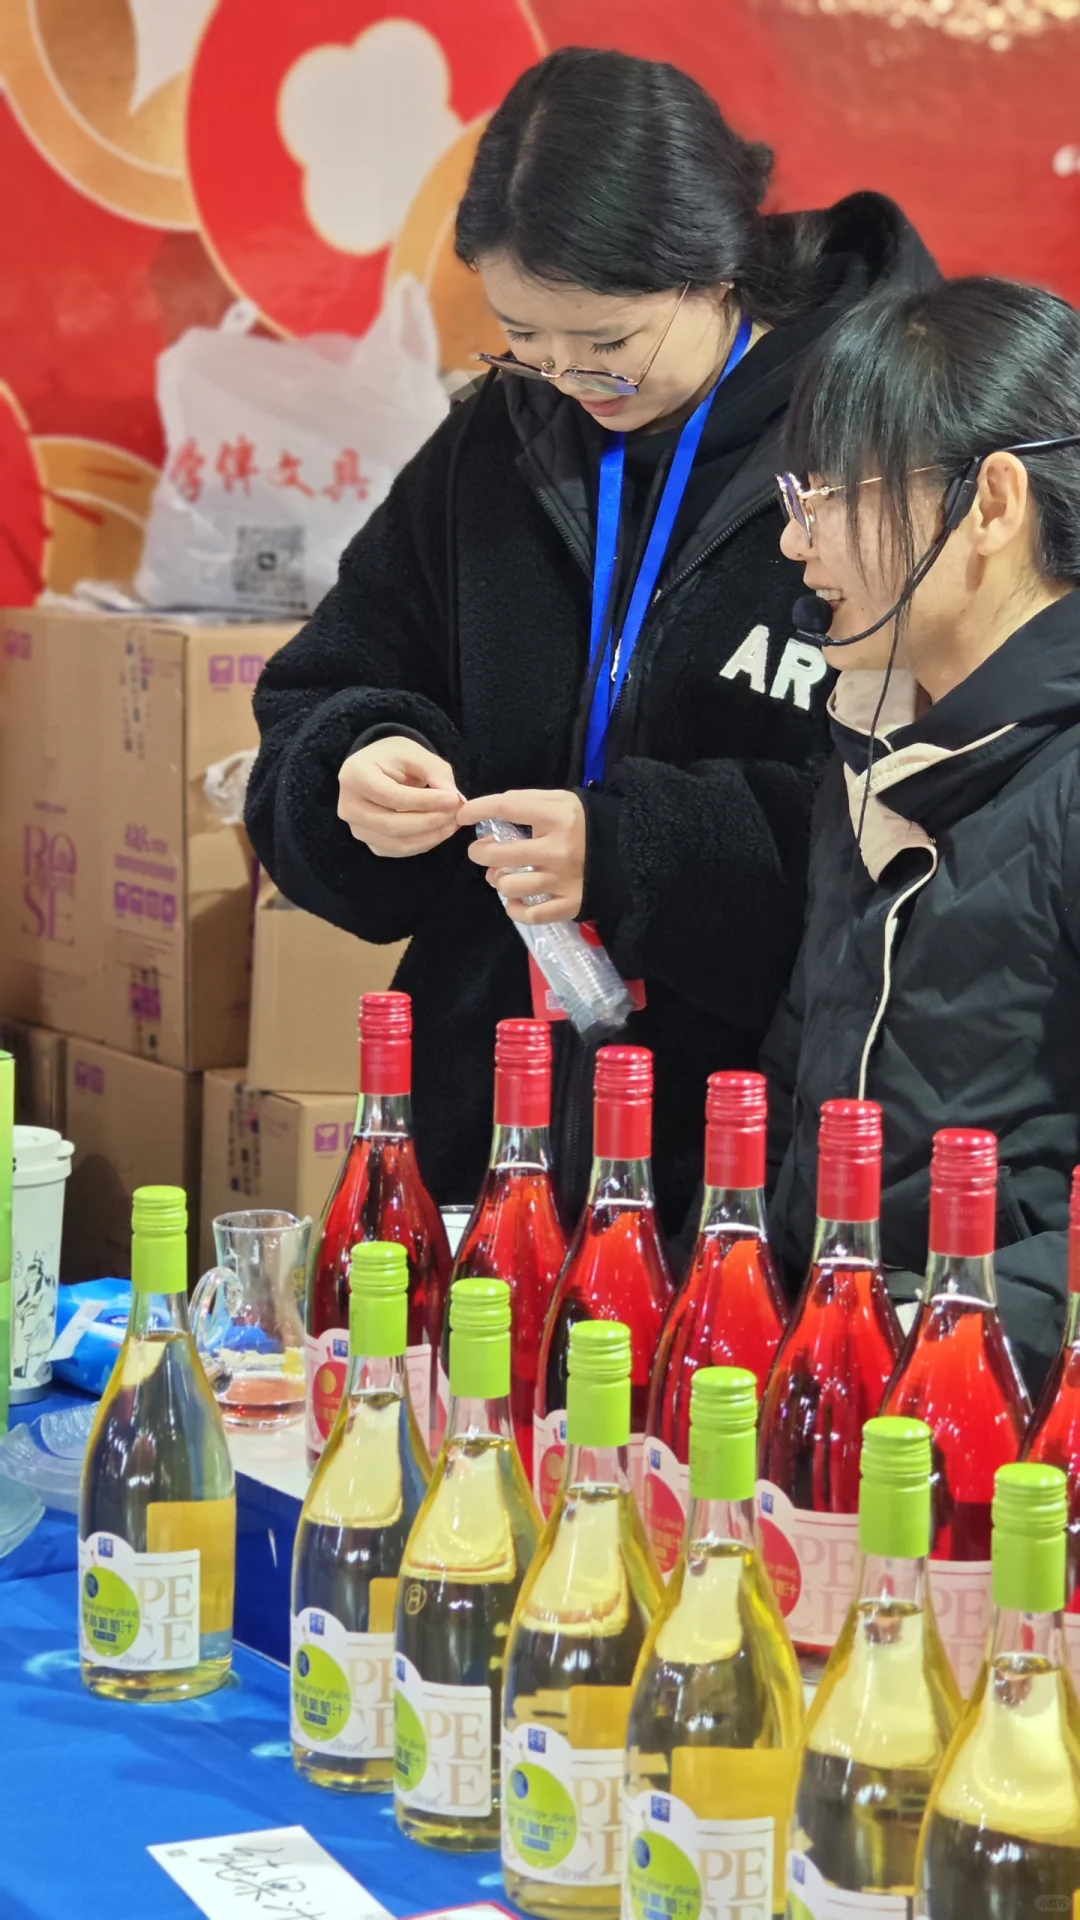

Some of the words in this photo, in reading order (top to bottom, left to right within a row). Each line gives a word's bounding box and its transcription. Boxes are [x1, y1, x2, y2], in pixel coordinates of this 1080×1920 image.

[719, 624, 827, 711] AR
[133, 1572, 196, 1621] PE
[424, 1709, 488, 1761] PE
[697, 1846, 768, 1901] PE
